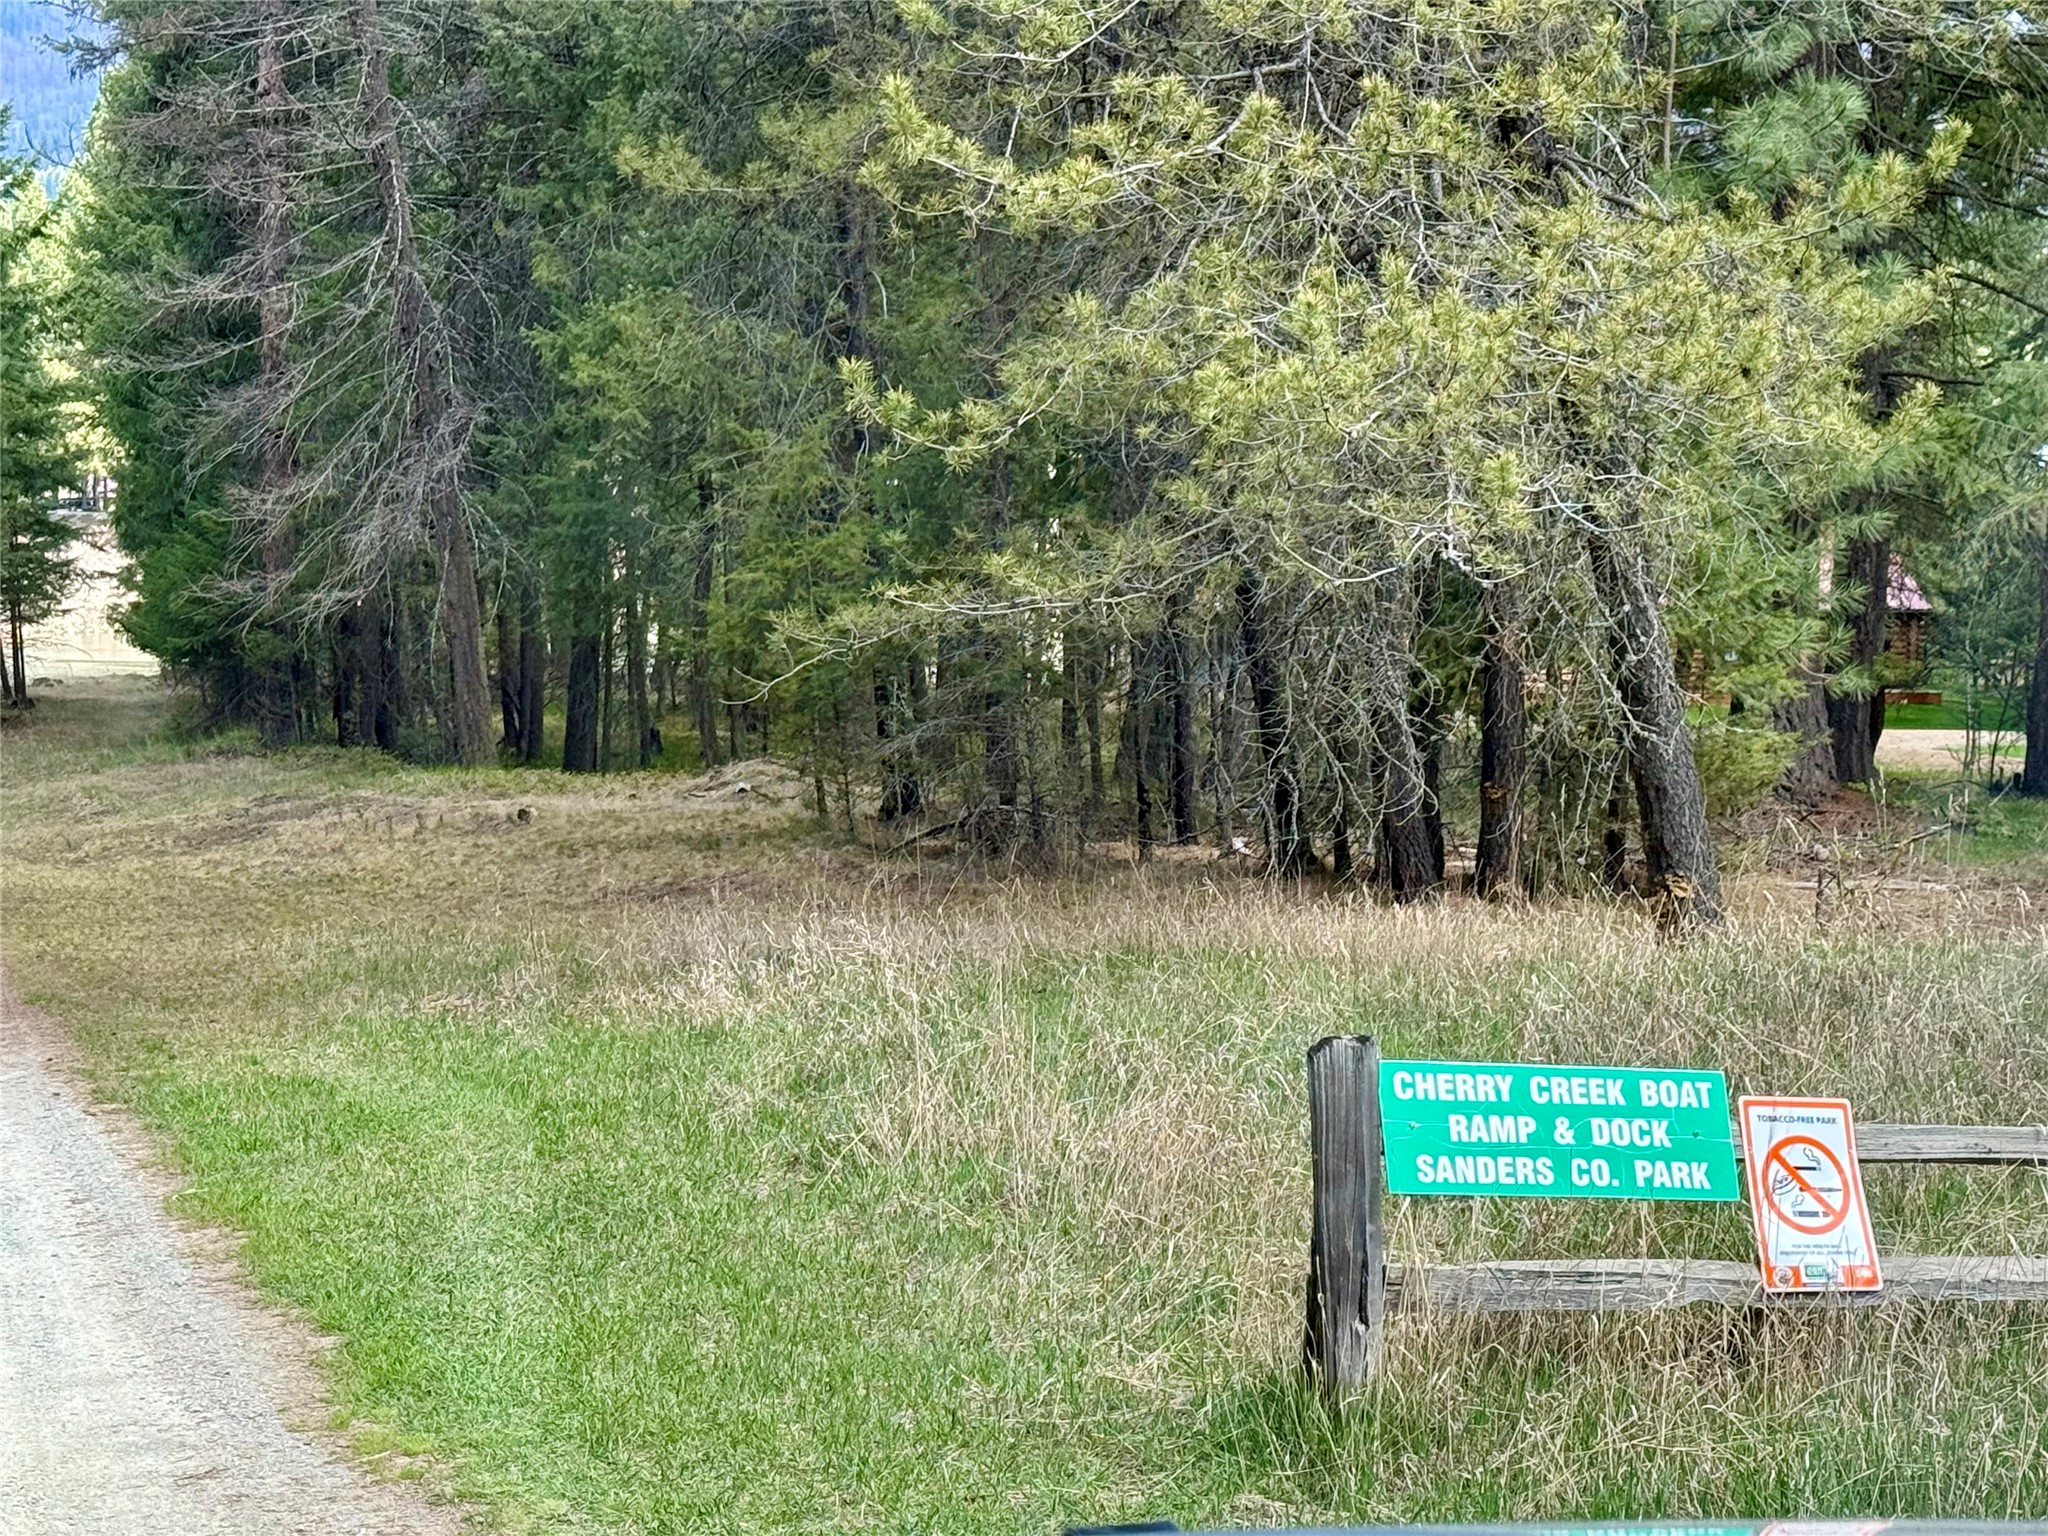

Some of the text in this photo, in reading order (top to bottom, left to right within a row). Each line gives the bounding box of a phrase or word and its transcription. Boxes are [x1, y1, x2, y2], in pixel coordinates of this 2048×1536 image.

[1393, 1071, 1713, 1109] CHERRY CREEK BOAT
[1448, 1114, 1672, 1148] RAMP & DOCK
[1816, 1116, 1838, 1125] PARK
[1416, 1154, 1712, 1190] SANDERS CO. PARK
